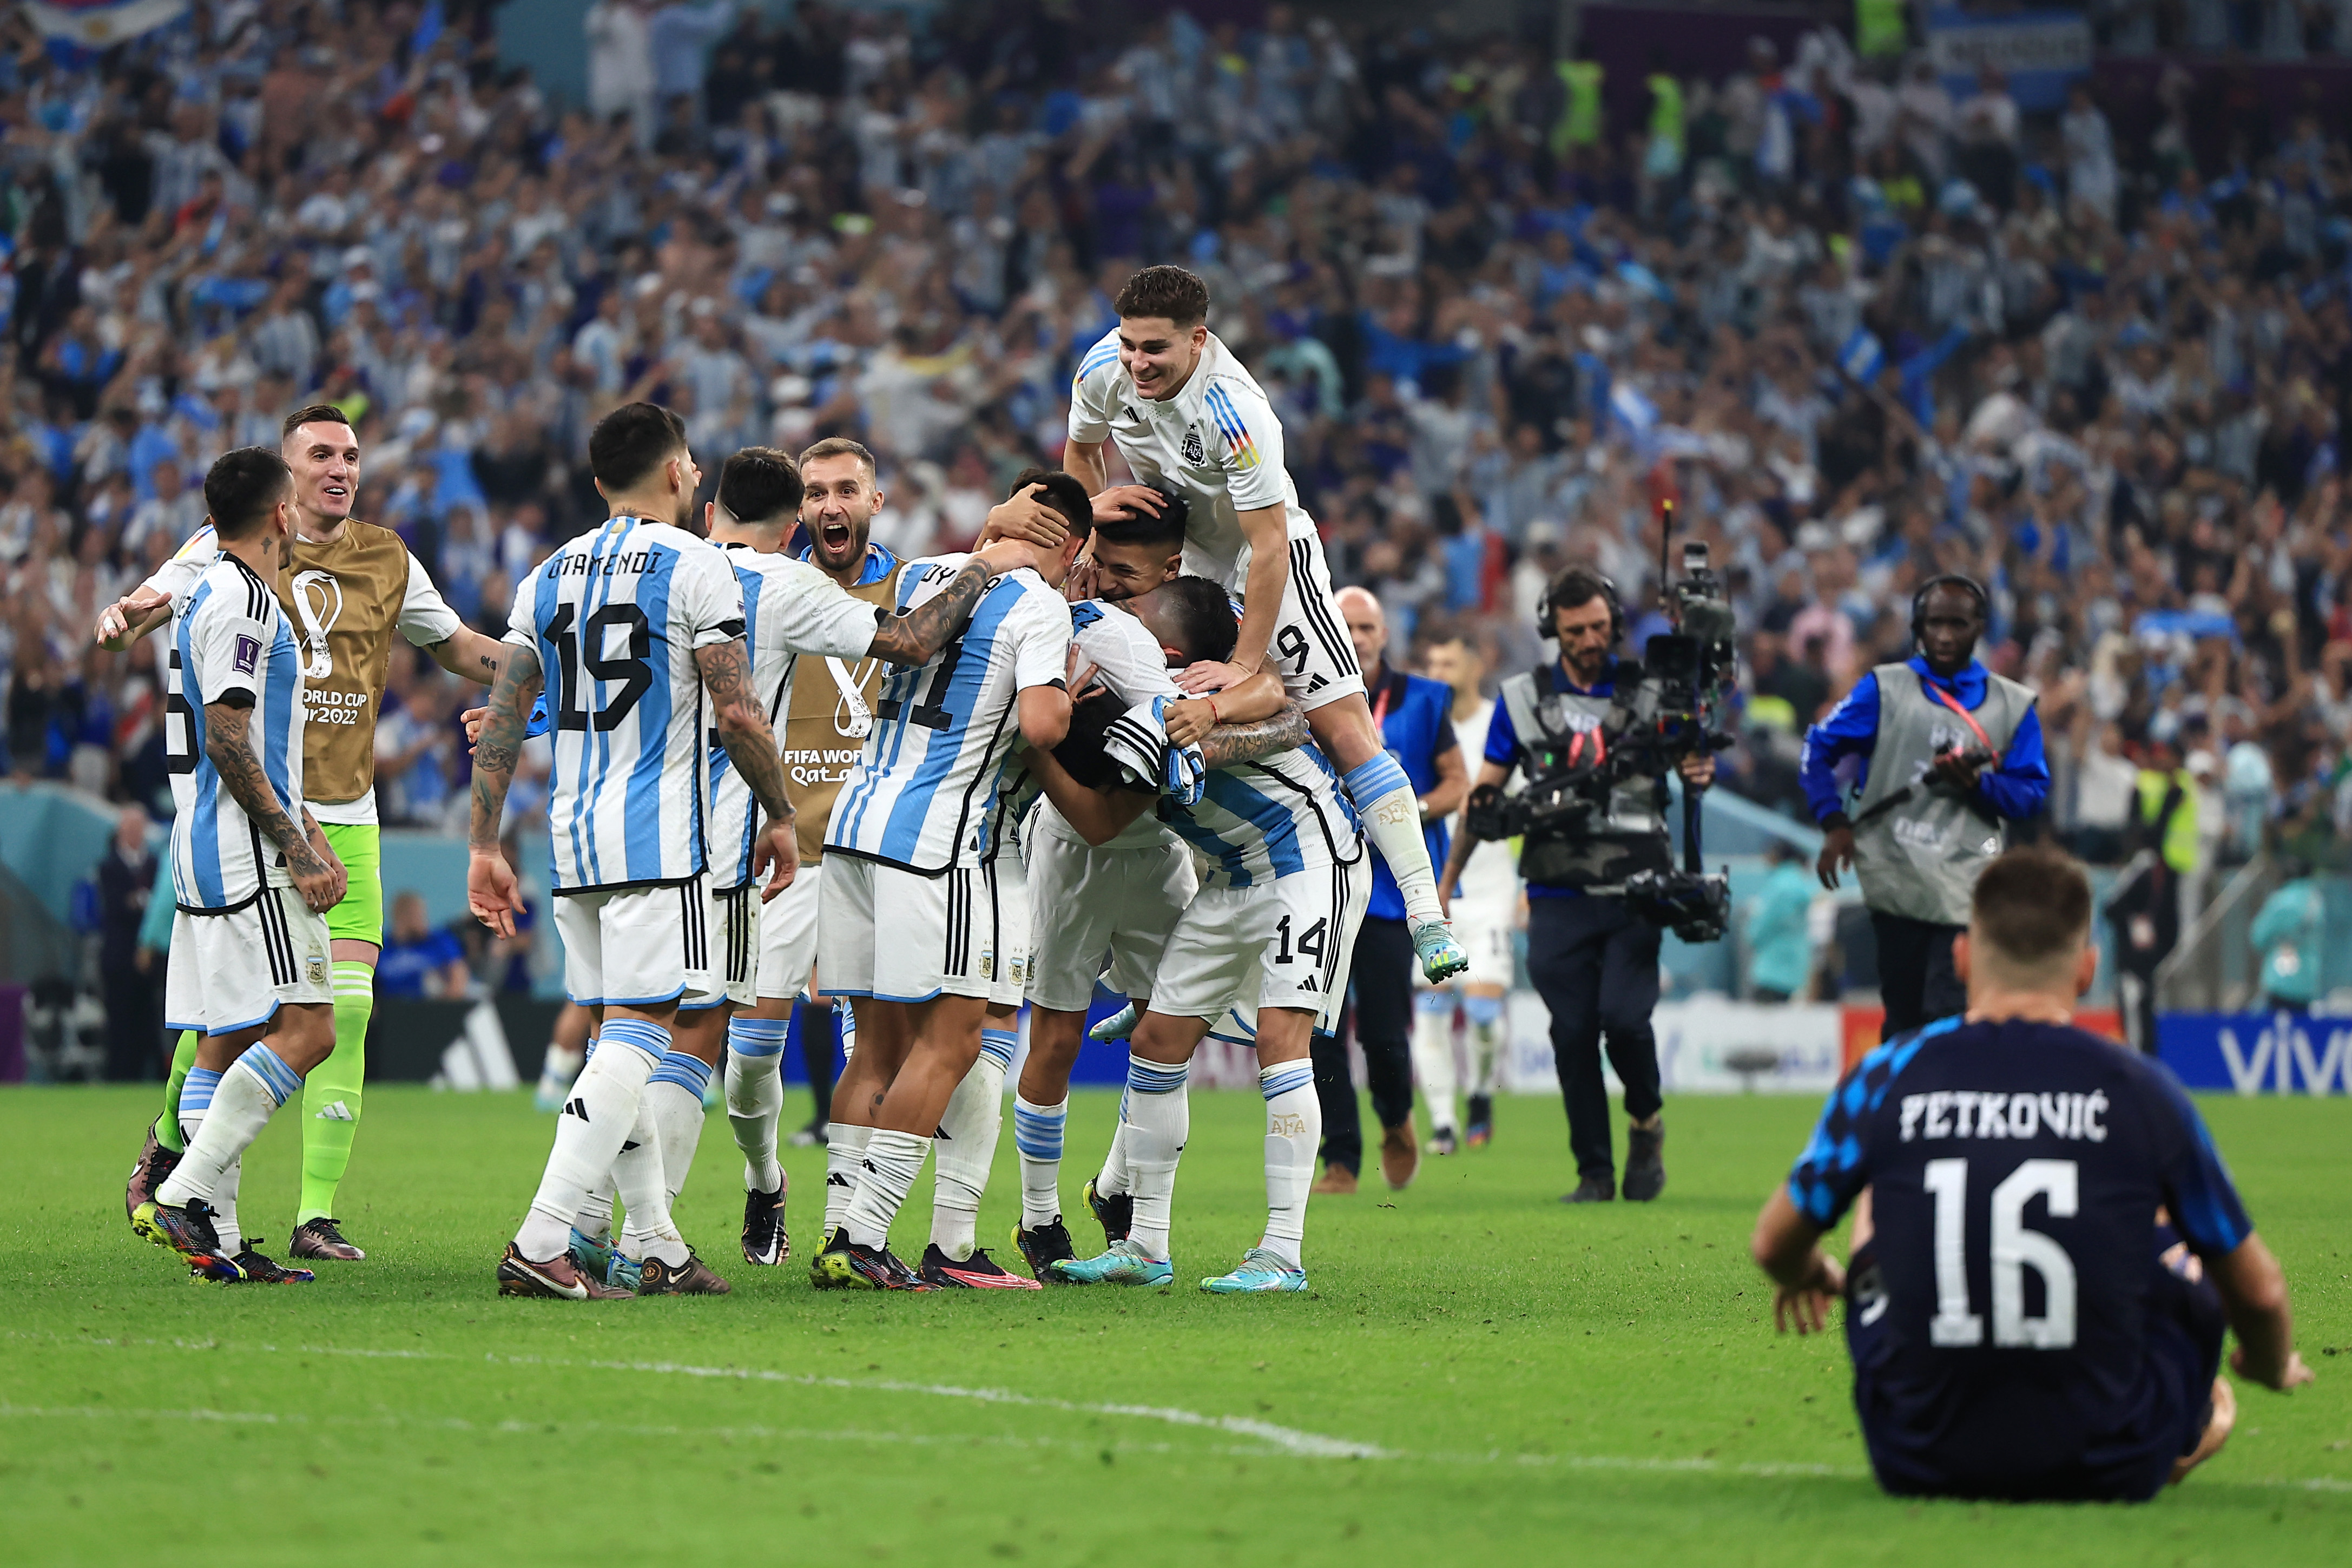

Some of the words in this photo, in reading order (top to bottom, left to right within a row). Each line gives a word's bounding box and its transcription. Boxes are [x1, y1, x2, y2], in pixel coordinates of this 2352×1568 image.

[548, 552, 662, 579] OTAMENDI
[543, 603, 652, 732] 19
[1277, 625, 1310, 675] 9
[303, 689, 342, 705] ORLD
[345, 693, 367, 707] CUP
[785, 750, 821, 764] FIFA
[1374, 799, 1411, 825] AFA
[1276, 914, 1327, 969] 14
[2217, 1010, 2352, 1096] viv
[1271, 1113, 1306, 1138] AFA
[1900, 1088, 2109, 1143] PETKOVIĆ
[1923, 1157, 2080, 1349] 16
